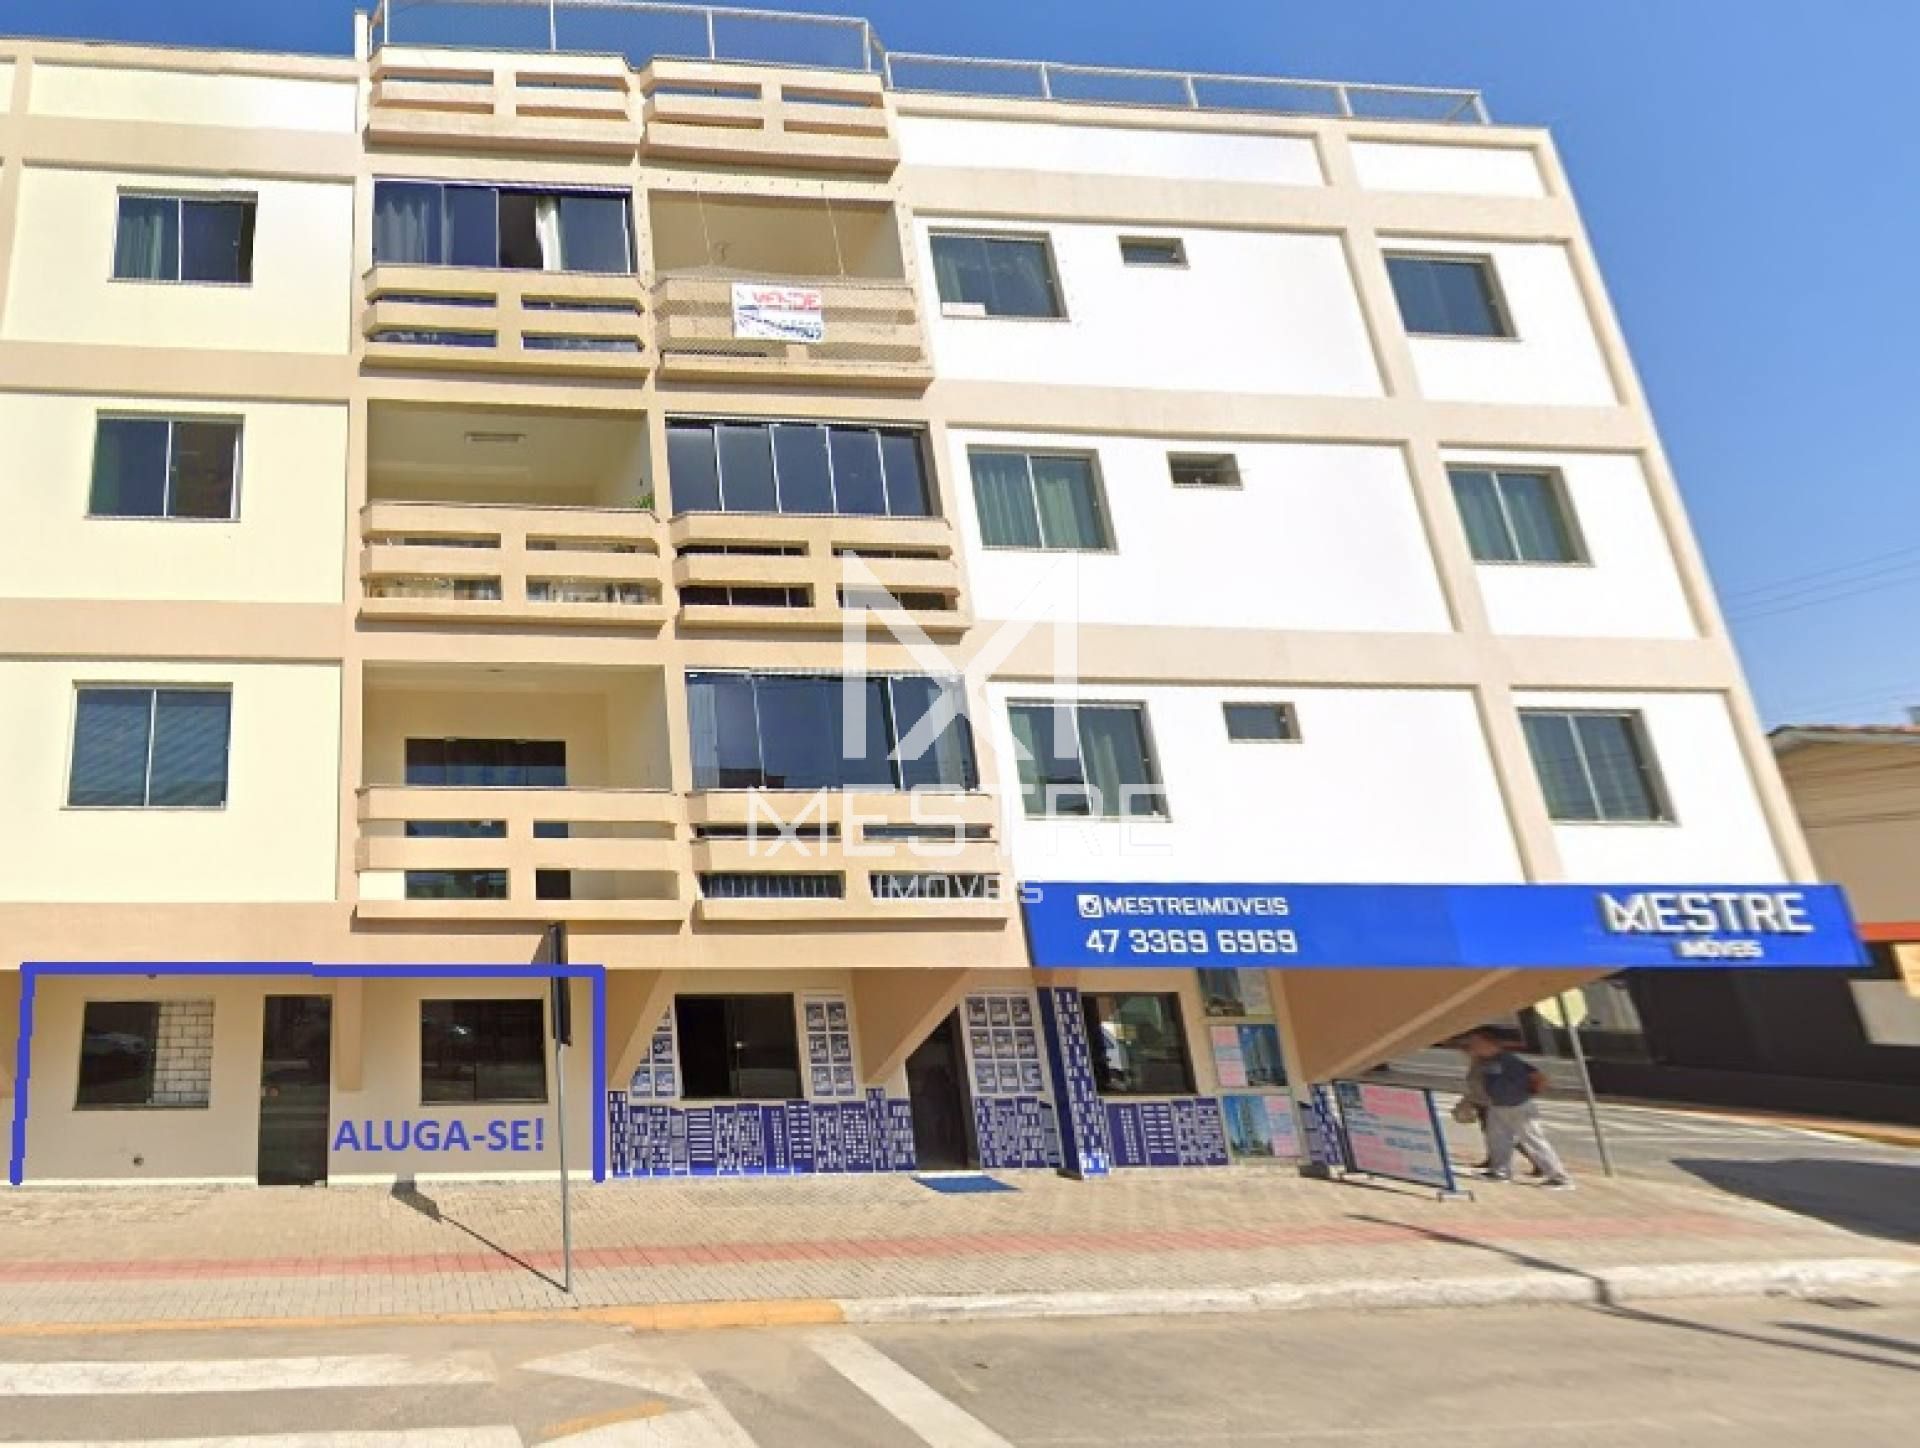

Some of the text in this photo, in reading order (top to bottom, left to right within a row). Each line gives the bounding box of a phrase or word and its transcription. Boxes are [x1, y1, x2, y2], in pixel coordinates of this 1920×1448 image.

[1103, 896, 1289, 916] MESTREIMOVEIS
[1600, 891, 1815, 933] MESTRE
[1086, 929, 1299, 953] 47 3369 6969
